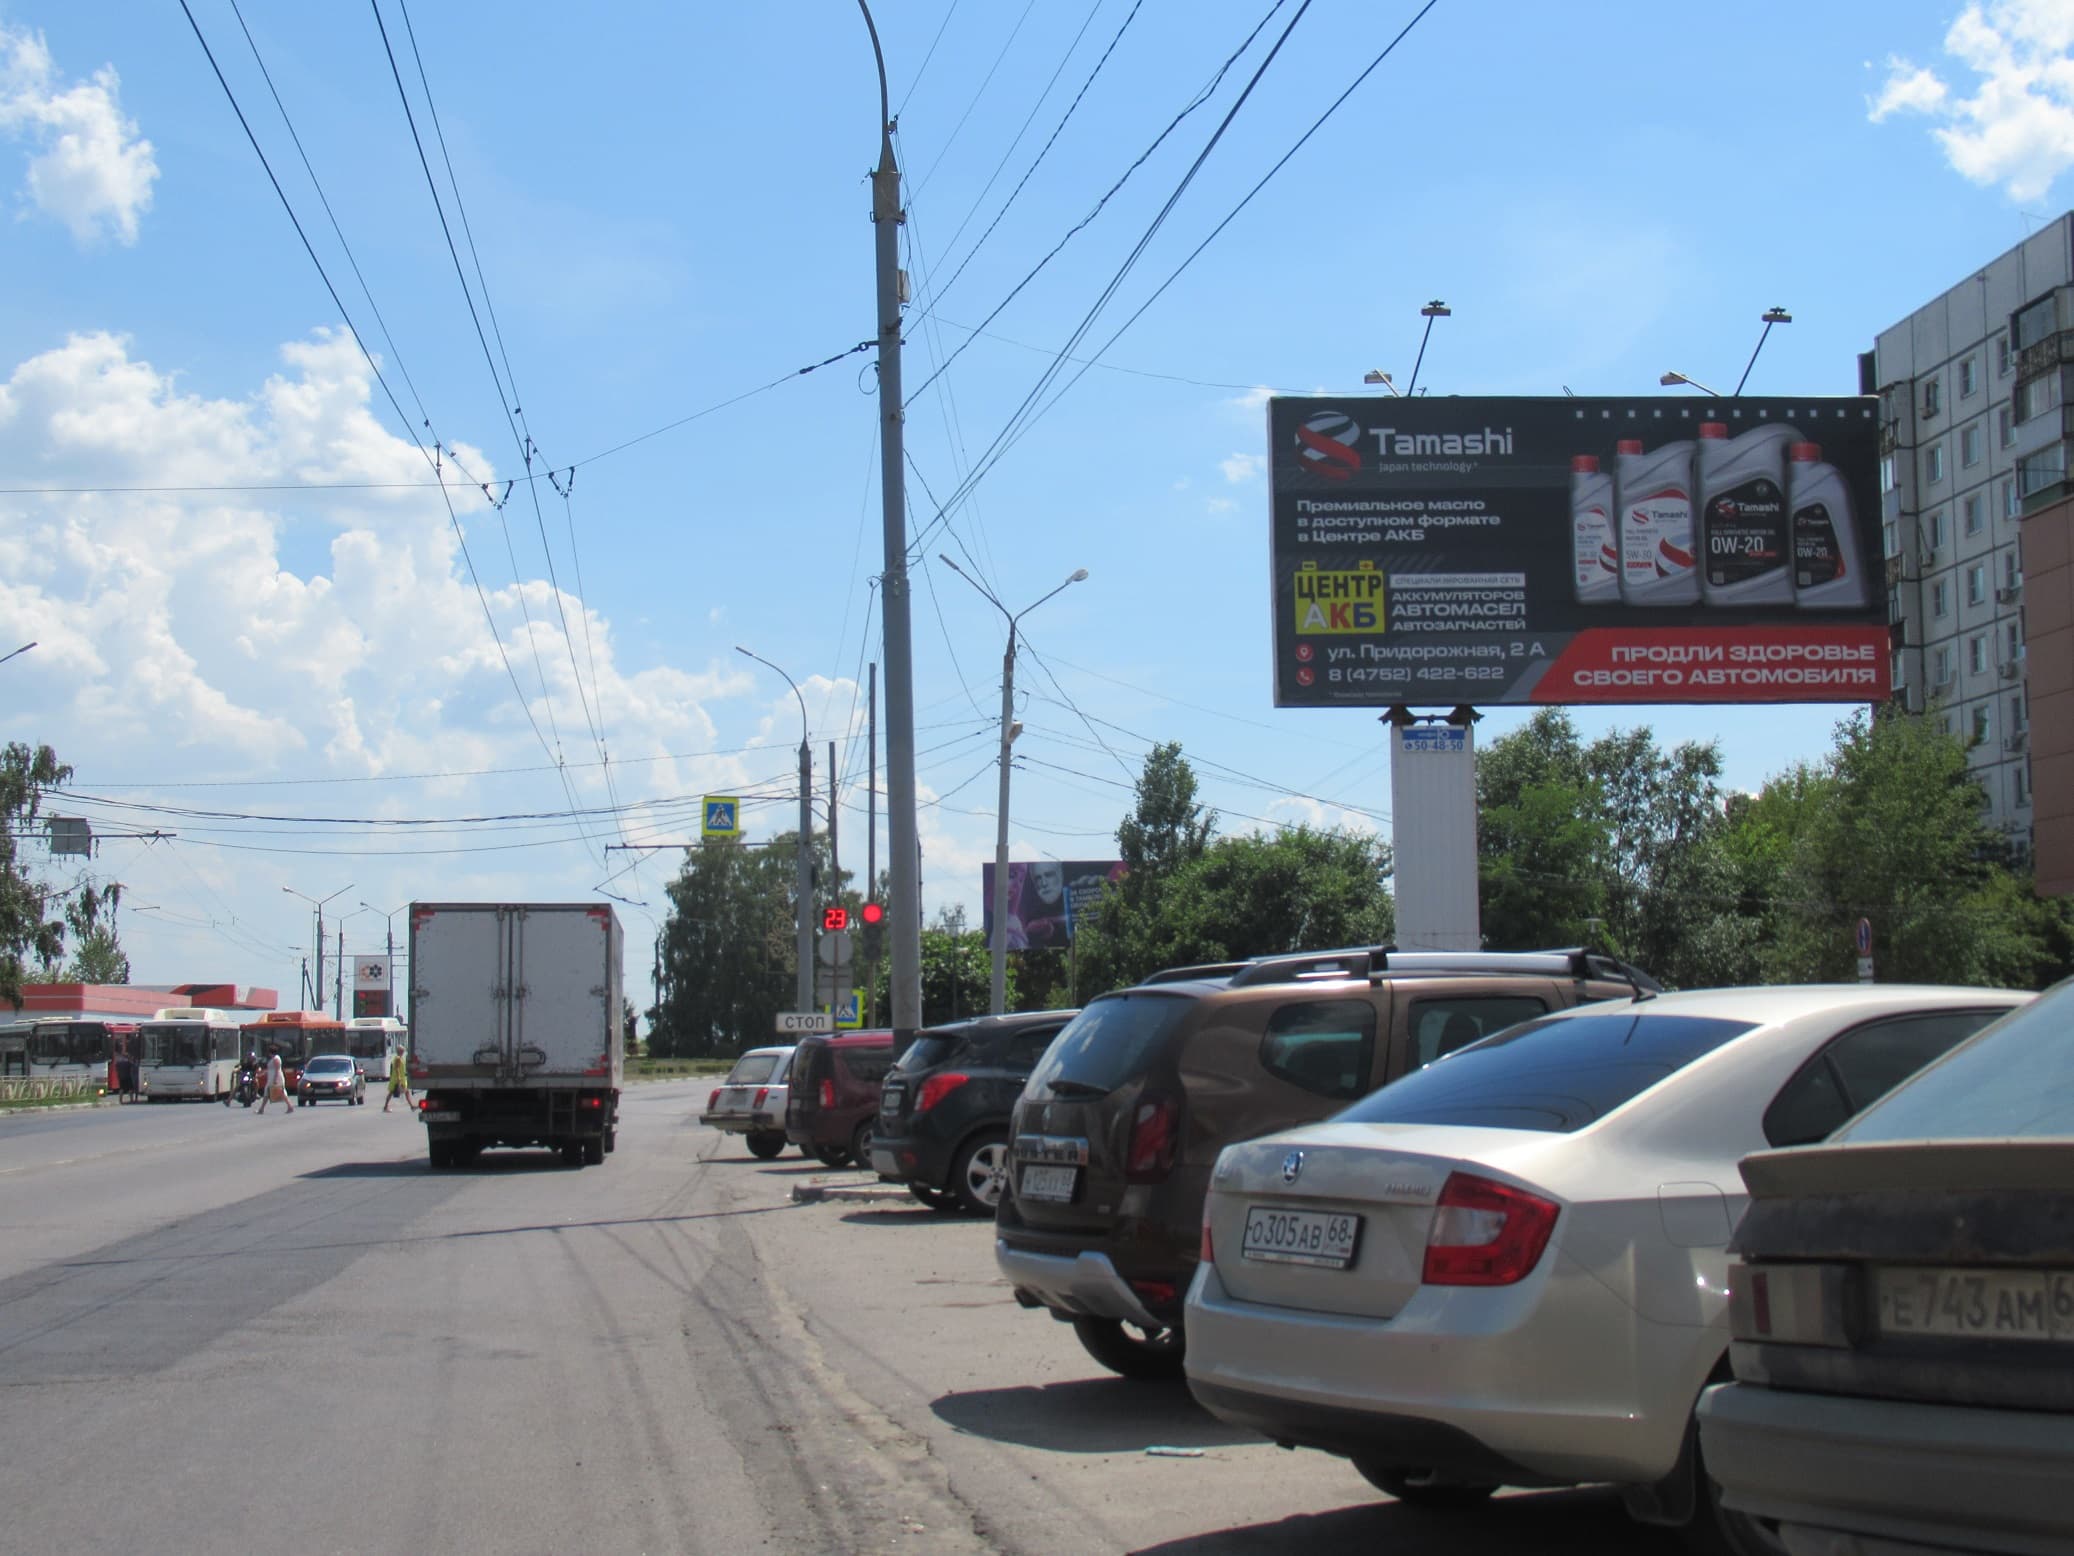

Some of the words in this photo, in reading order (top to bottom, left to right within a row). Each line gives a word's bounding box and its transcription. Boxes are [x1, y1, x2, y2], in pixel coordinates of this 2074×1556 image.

[1369, 428, 1512, 455] Tamashi
[1297, 500, 1424, 513] Премиальное
[1428, 500, 1485, 511] масло
[1737, 502, 1779, 513] Tamashi
[1297, 516, 1308, 526] в
[1312, 515, 1414, 529] доступном
[1417, 513, 1501, 528] формате
[1297, 532, 1308, 542] в
[1312, 530, 1381, 544] Центре
[1386, 529, 1425, 541] АКБ
[1297, 574, 1382, 602] ЦЕНТР
[1392, 590, 1525, 601] АККУМУЛЯТОРОВ
[1303, 603, 1377, 629] АКБ
[1392, 603, 1525, 617] АВТОМАСЕЛ
[1392, 618, 1526, 631] АВТОЗАПЧАСТЕЙ
[1328, 646, 1356, 662] ул.
[1360, 644, 1505, 661] Придорожная,
[1510, 642, 1525, 656] 2
[1529, 641, 1545, 656] А
[1611, 646, 1725, 663] ПРОДЛИ
[1729, 645, 1875, 662] ЗДОРОВЬЕ
[1328, 668, 1342, 681] 8
[1347, 667, 1411, 683] (4752)
[1416, 666, 1505, 680] 422-622
[1573, 669, 1682, 686] СВОЕГО
[1688, 668, 1876, 685] АВТОМОБИЛЯ
[825, 909, 847, 929] 23
[785, 1016, 825, 1030] СТОП
